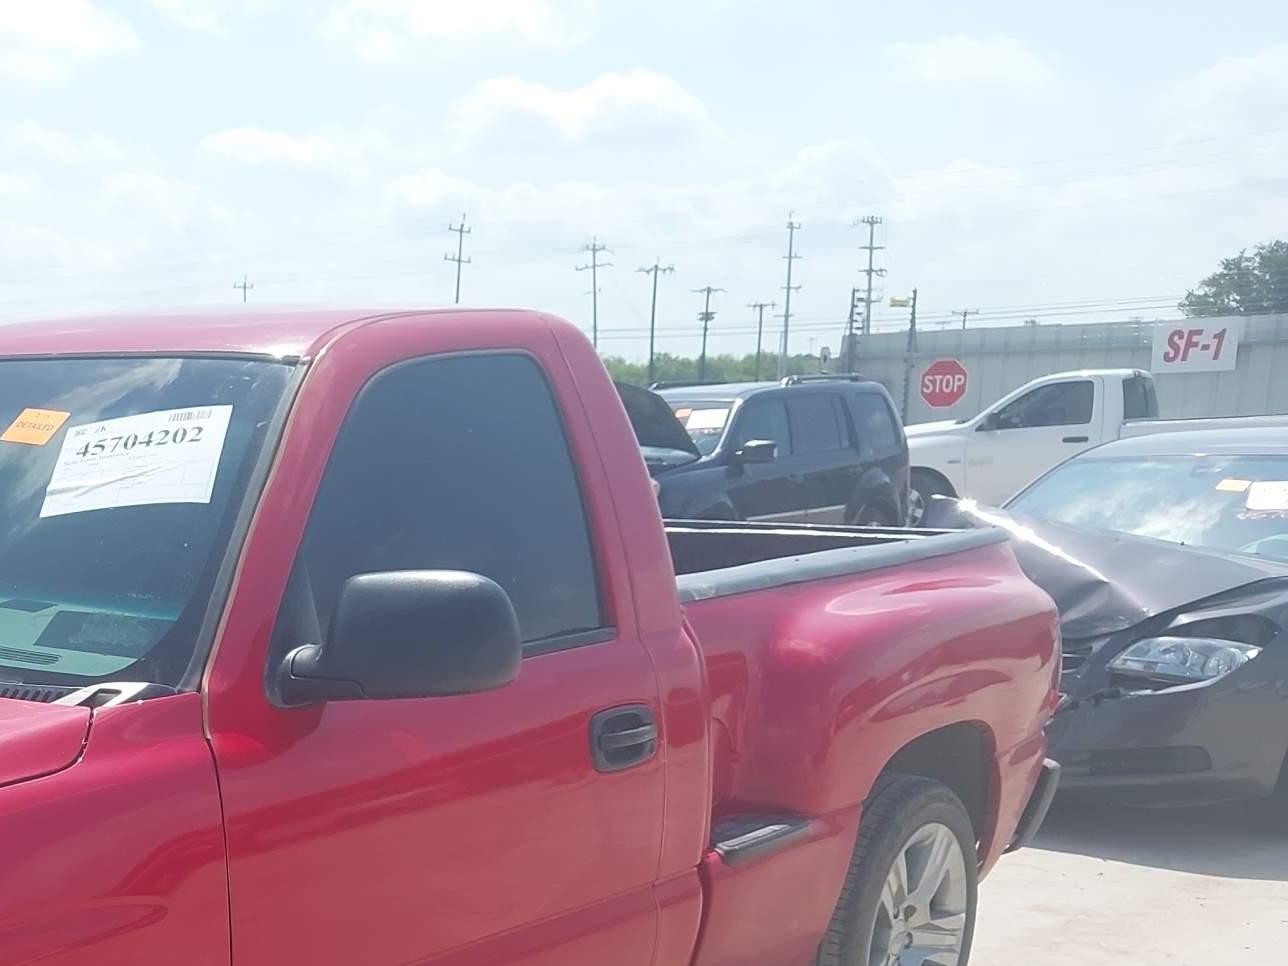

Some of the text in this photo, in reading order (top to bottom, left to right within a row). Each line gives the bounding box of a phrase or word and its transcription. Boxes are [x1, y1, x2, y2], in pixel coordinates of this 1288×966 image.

[1162, 327, 1228, 363] SF-1
[922, 373, 965, 394] STOP
[75, 426, 204, 457] 45704202
